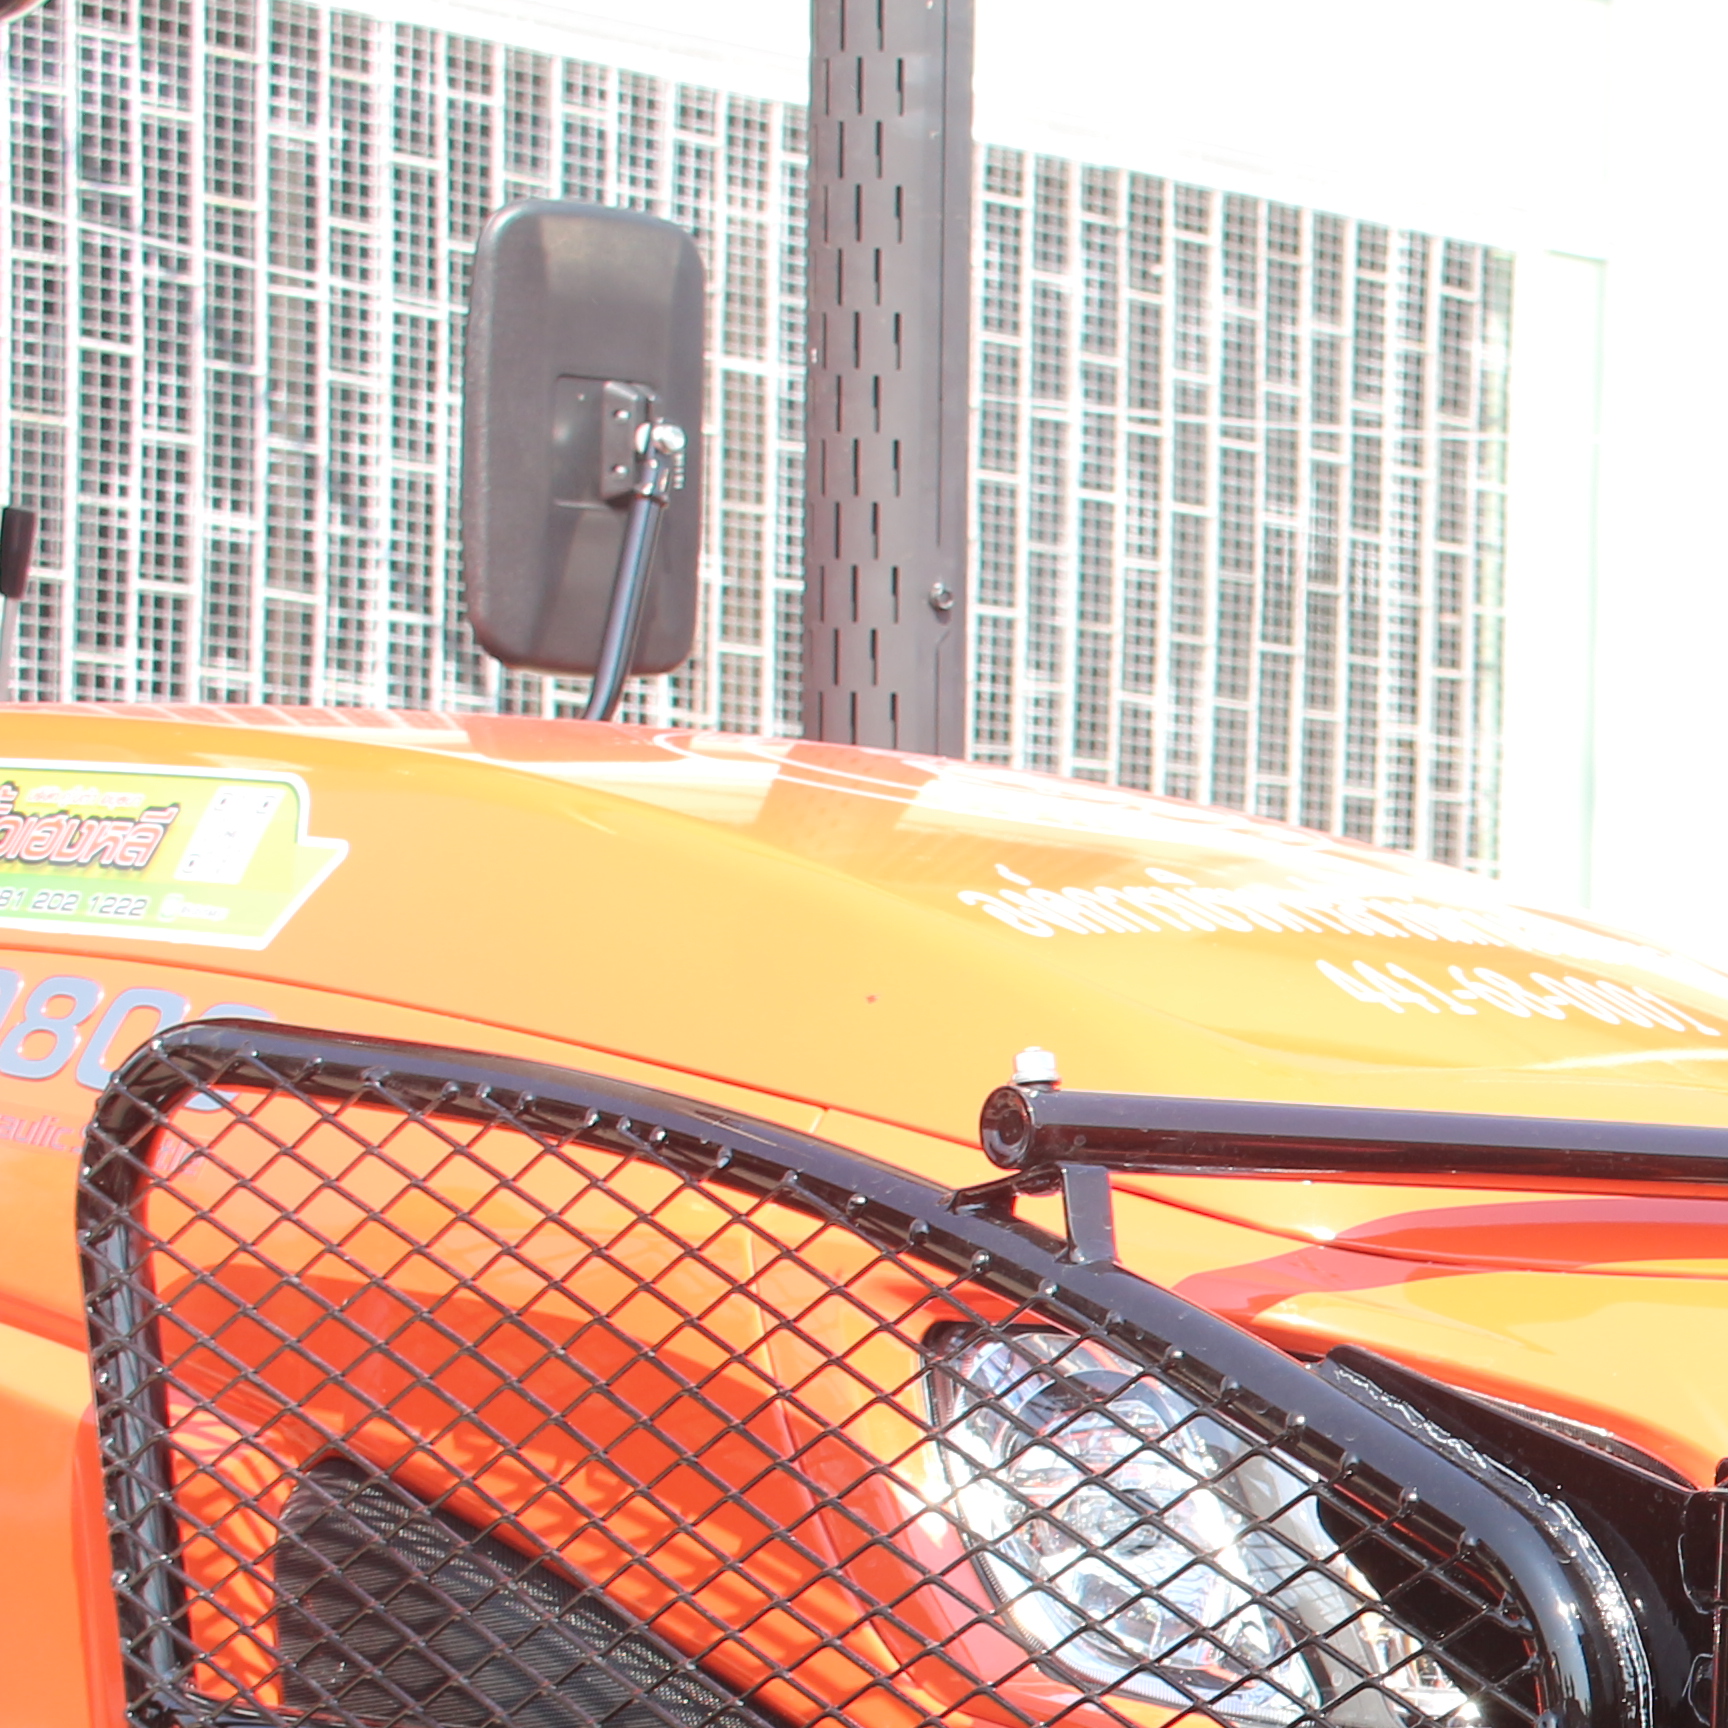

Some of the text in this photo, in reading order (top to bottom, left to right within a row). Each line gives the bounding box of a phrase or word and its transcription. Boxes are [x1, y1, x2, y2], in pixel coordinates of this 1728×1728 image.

[32, 891, 79, 913] 202
[89, 895, 148, 917] 1222
[1314, 958, 1722, 1038] 441-68-0001
